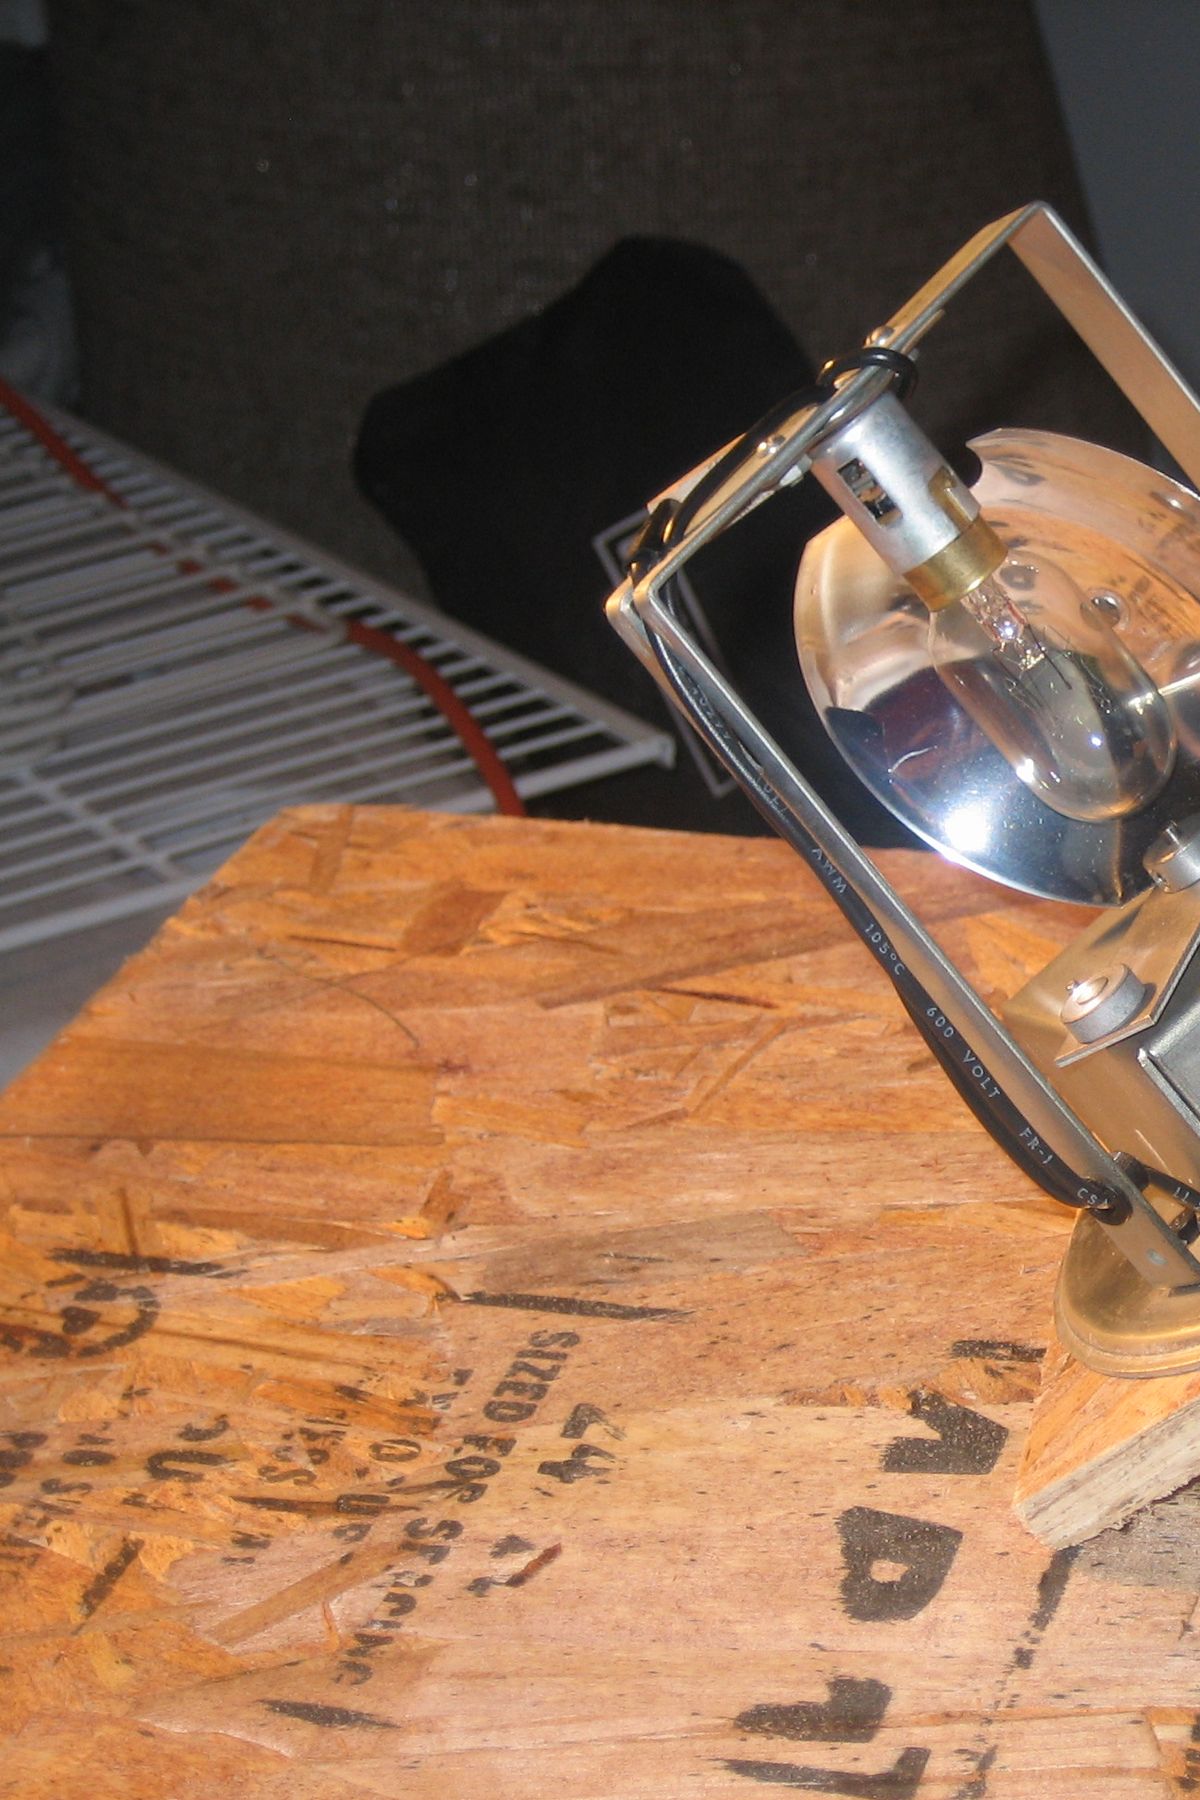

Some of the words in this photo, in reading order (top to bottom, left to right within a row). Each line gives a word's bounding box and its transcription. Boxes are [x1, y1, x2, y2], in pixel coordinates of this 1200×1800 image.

[811, 848, 848, 894] AWM
[863, 923, 906, 976] 105°C
[925, 1006, 955, 1039] 600
[962, 1049, 1001, 1098] VOLT
[1019, 1127, 1054, 1165] FR-1
[482, 1329, 581, 1424] SIZED
[444, 1433, 518, 1505] FOR
